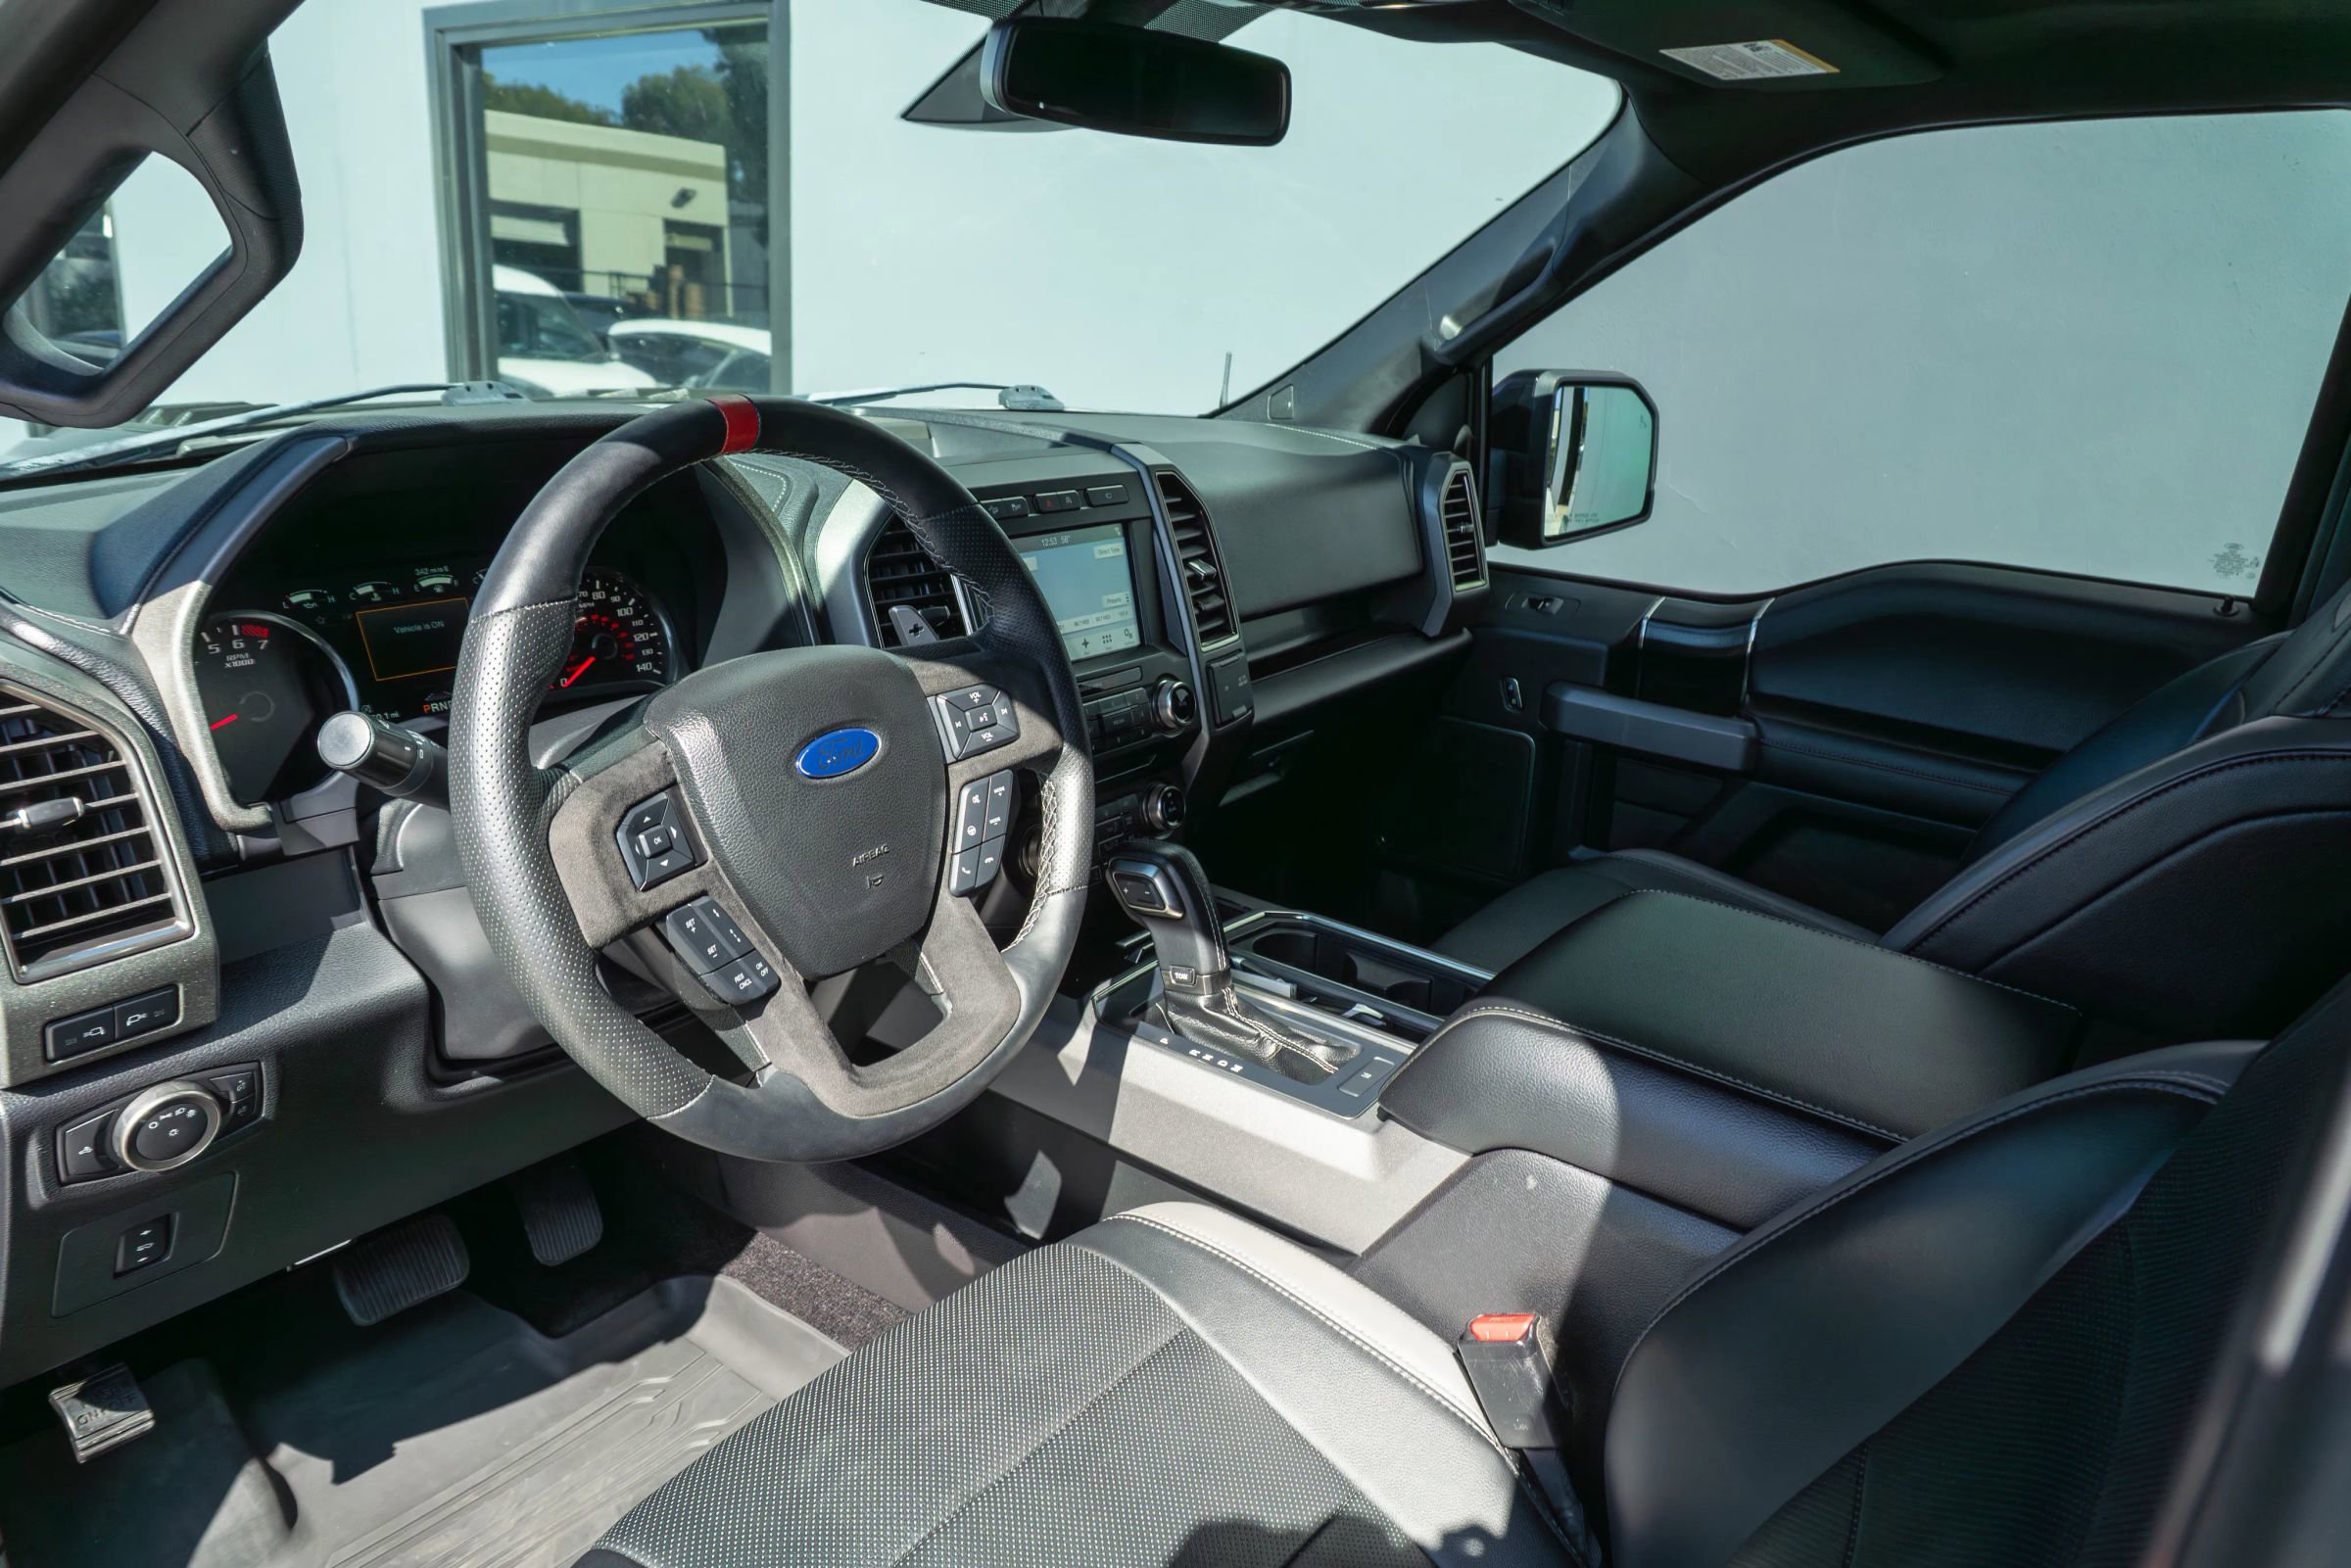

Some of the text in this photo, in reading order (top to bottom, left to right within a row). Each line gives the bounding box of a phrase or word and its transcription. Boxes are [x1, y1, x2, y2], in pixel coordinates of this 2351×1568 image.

[592, 592, 606, 600] 80
[616, 607, 634, 617] 100
[394, 625, 422, 634] Vehicle
[634, 632, 649, 641] 120
[208, 643, 221, 654] 5
[231, 639, 245, 649] 6
[258, 640, 269, 649] 7
[226, 652, 249, 662] RPM
[636, 662, 652, 672] 140
[969, 690, 982, 700] VOL
[981, 732, 993, 740] VOL
[653, 835, 662, 844] OK
[852, 843, 890, 867] AIRBAG
[686, 918, 696, 928] SET
[707, 944, 717, 955] SET
[760, 967, 769, 976] OFF
[1175, 972, 1188, 980] TOW
[734, 973, 744, 983] RES
